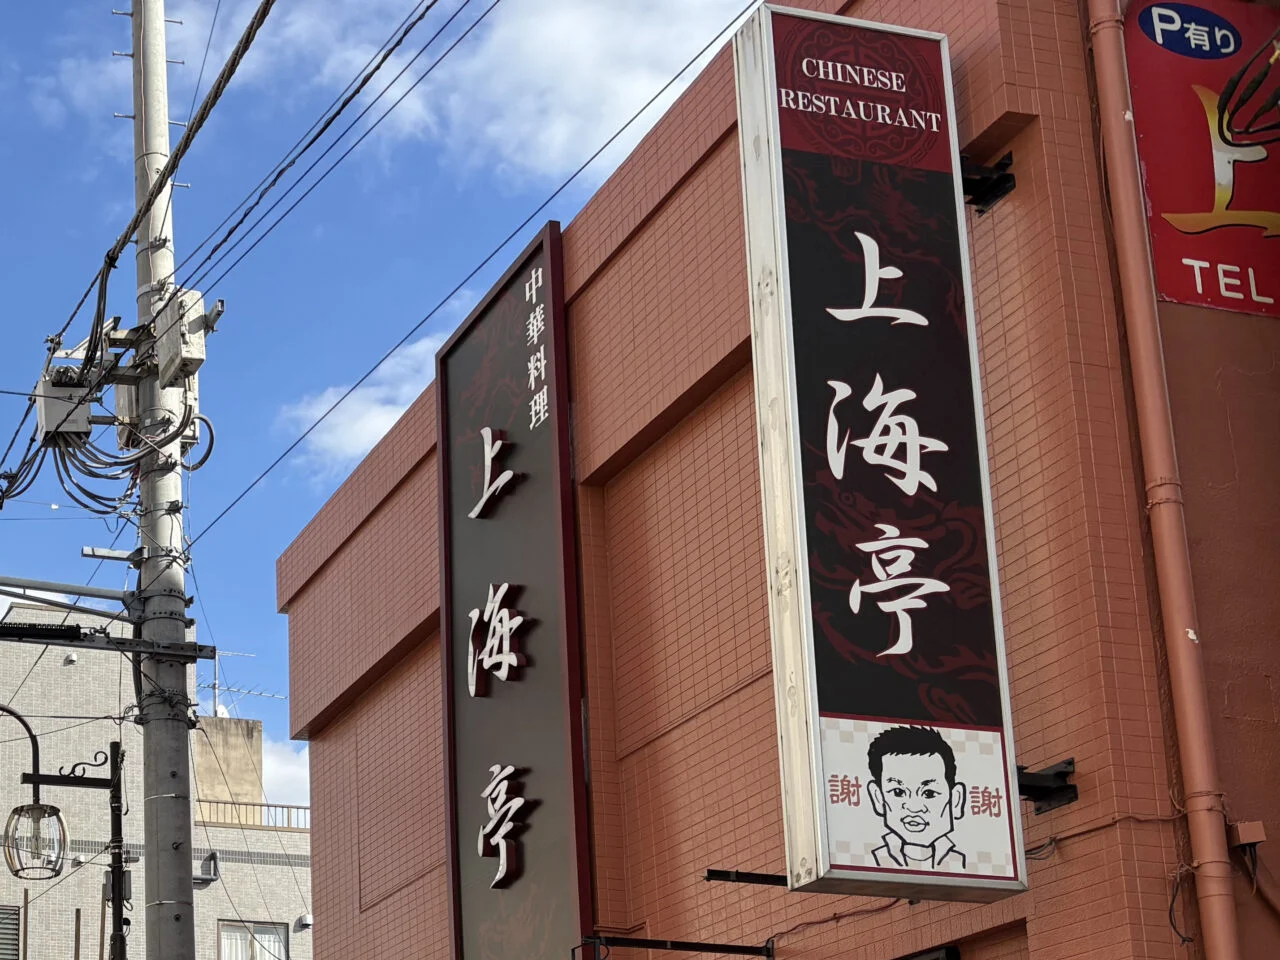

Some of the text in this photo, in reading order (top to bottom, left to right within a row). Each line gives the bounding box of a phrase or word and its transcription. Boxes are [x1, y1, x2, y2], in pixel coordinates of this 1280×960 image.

[1151, 7, 1235, 53] P有り
[801, 57, 907, 93] CHINESE
[779, 88, 942, 133] RESTAURANT
[1182, 258, 1274, 304] TEL
[525, 267, 549, 432] 中華料理
[826, 231, 950, 657] 上海亭
[468, 426, 524, 889] 上海亭
[828, 774, 1002, 819] 謝 謝
